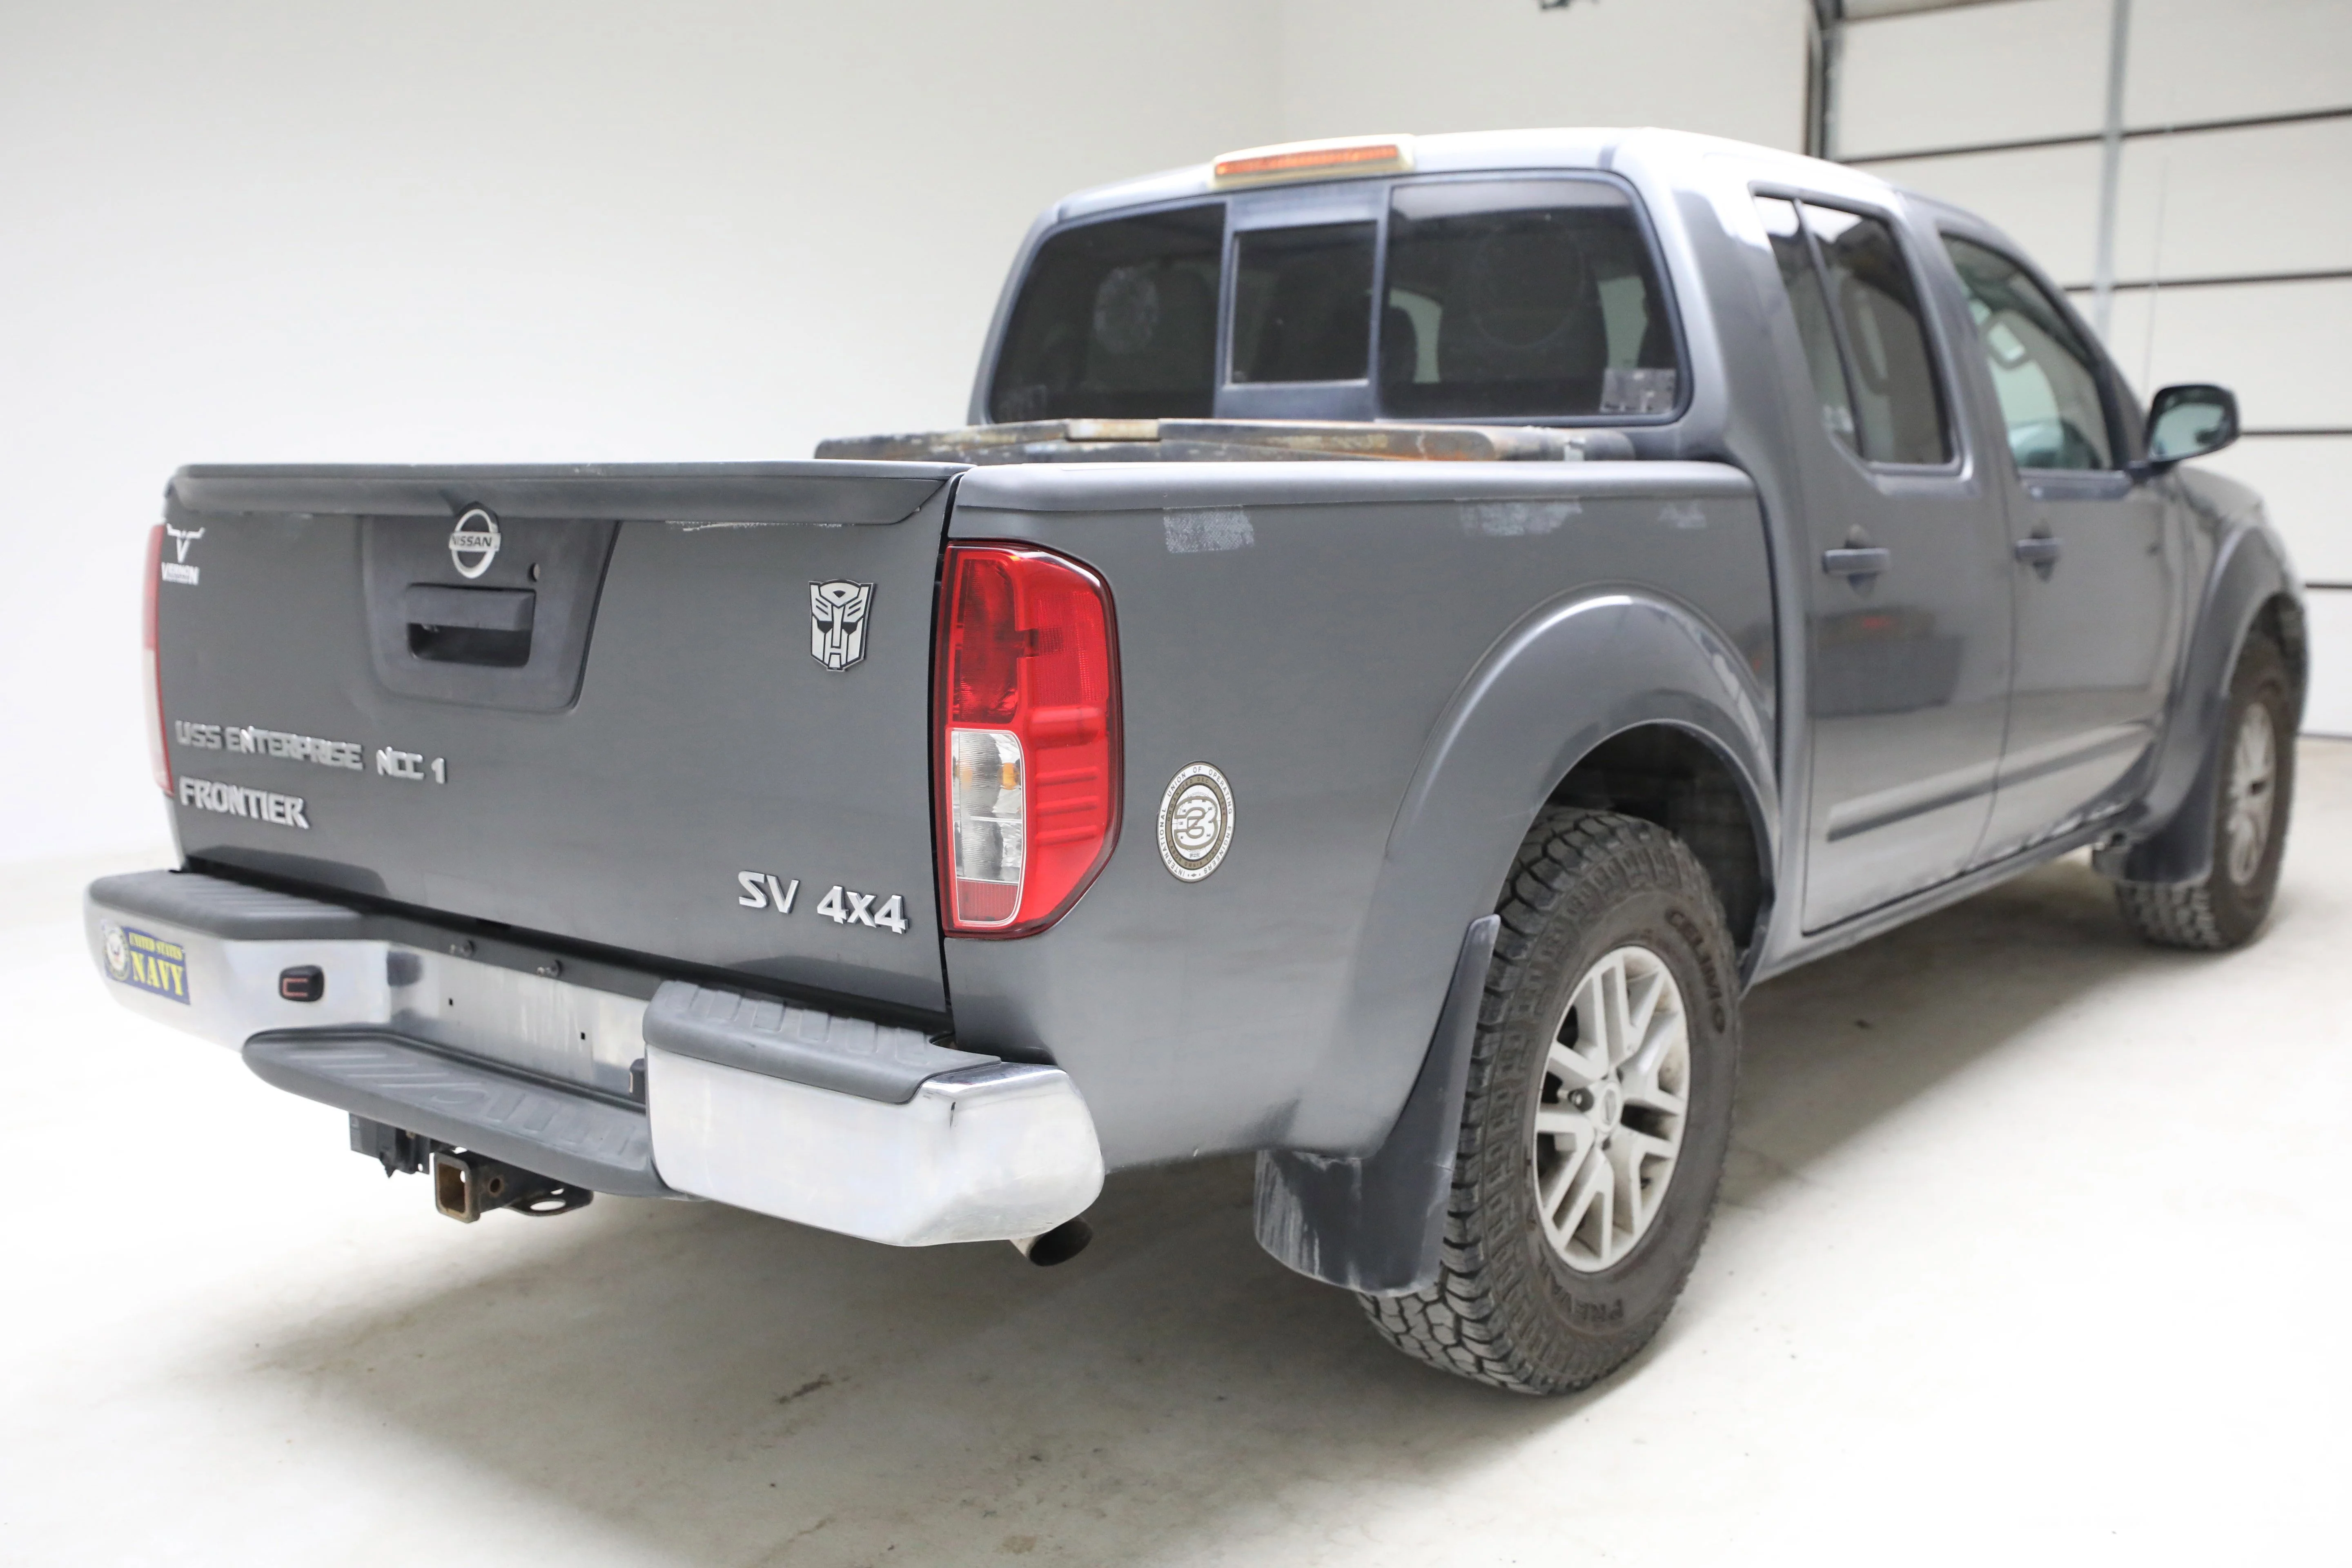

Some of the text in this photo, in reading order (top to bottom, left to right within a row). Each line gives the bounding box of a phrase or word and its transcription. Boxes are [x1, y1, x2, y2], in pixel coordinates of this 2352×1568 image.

[452, 535, 492, 546] NISSAN
[175, 720, 222, 749] USS
[224, 725, 363, 771] ENTERPRISE
[431, 757, 445, 784] 1
[179, 775, 309, 829] FRONTIER
[1167, 772, 1186, 797] UNION
[1209, 769, 1233, 815] OPERATING
[1160, 808, 1185, 877] INTERNATIONAL
[1204, 826, 1232, 874] ENGINEERS
[738, 871, 799, 914] SV
[131, 951, 183, 996] NAVY
